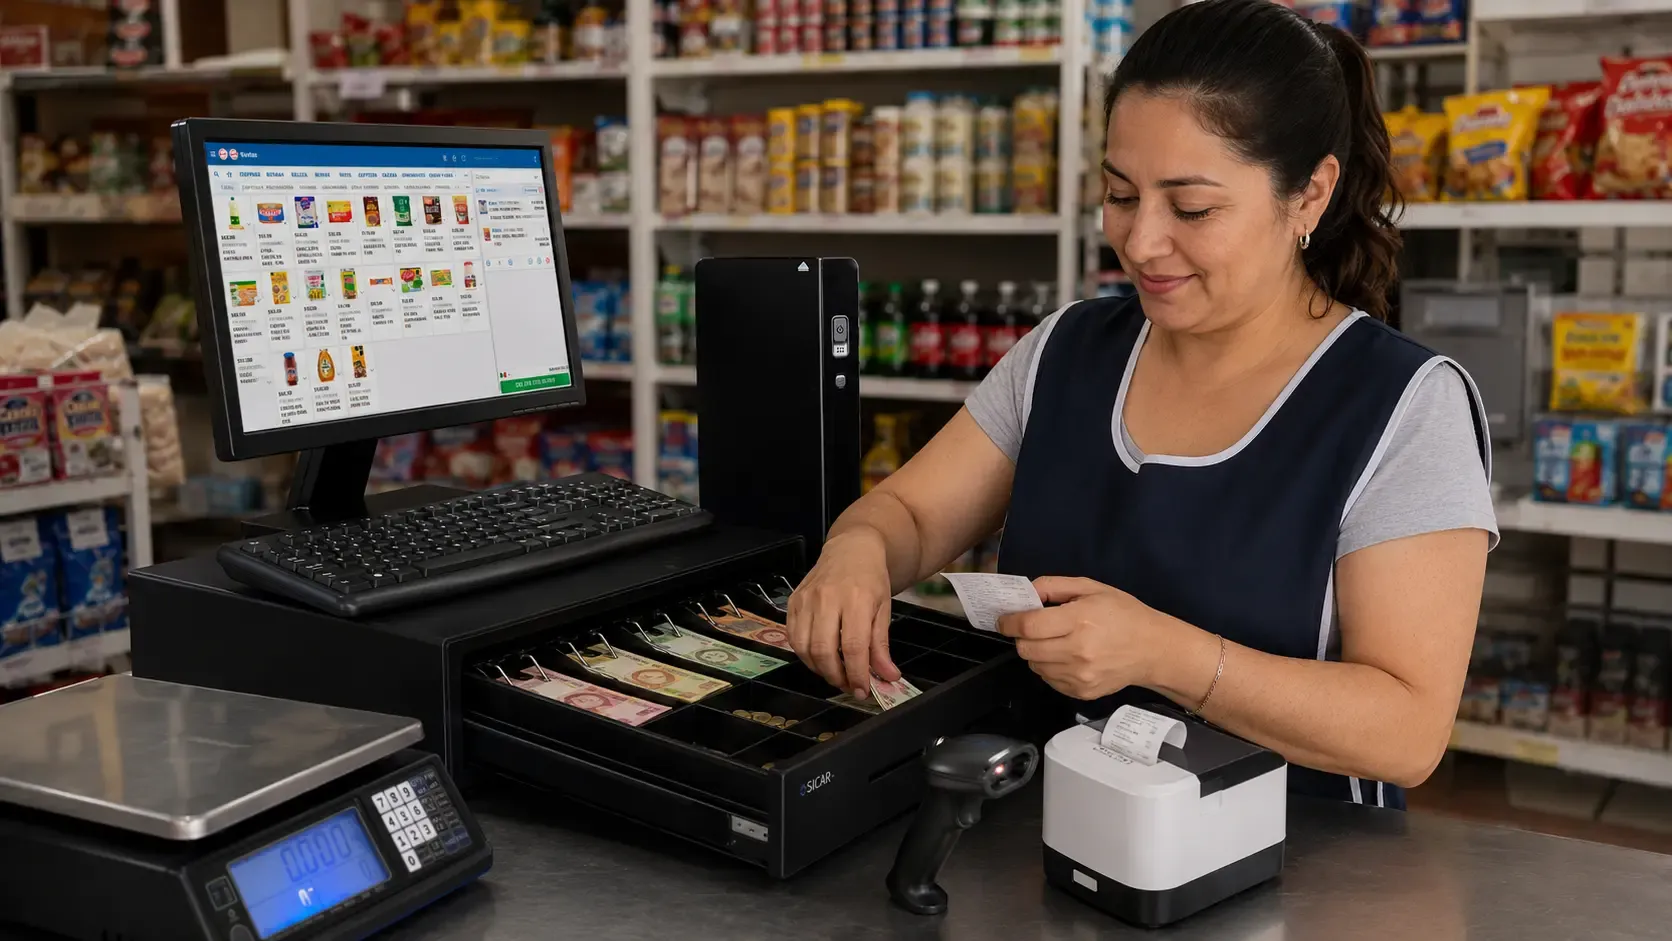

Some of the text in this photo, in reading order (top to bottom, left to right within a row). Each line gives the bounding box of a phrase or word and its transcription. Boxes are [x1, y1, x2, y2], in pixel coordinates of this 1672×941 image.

[806, 771, 831, 793] SICAR
[376, 787, 410, 808] 7 8 9
[388, 816, 396, 827] 4
[413, 805, 421, 815] 6
[398, 824, 431, 847] 1 2 3
[407, 855, 416, 866] 0
